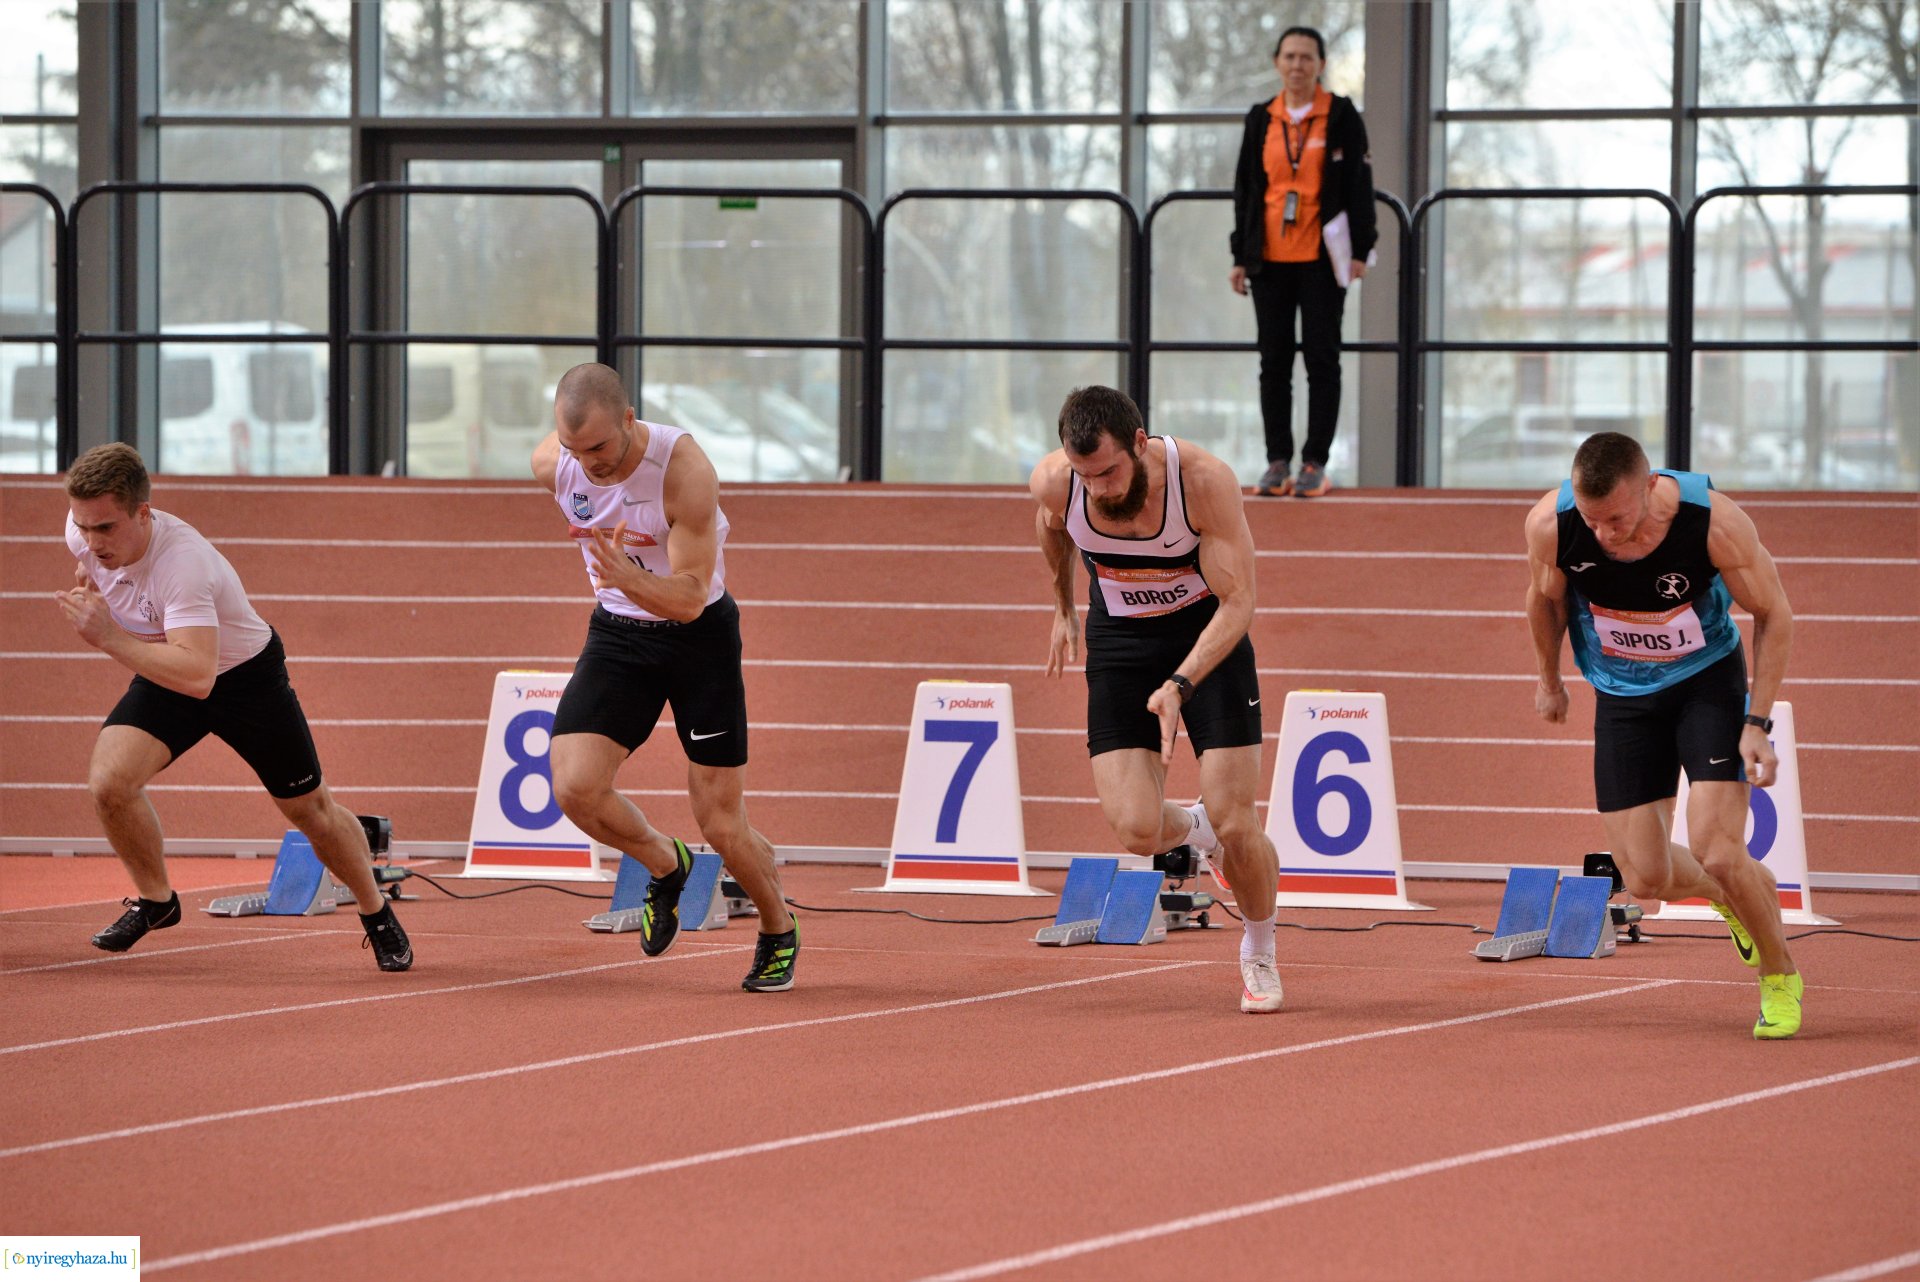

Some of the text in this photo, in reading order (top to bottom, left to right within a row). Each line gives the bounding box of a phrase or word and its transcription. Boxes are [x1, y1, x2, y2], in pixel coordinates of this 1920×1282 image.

[1120, 584, 1188, 605] BOROS
[1610, 629, 1692, 651] SIPOS J.
[948, 697, 995, 710] polanik
[1320, 707, 1370, 720] polanik
[298, 774, 313, 785] JAKO
[499, 709, 564, 831] 8
[923, 719, 999, 844] 7
[1292, 730, 1372, 857] 6
